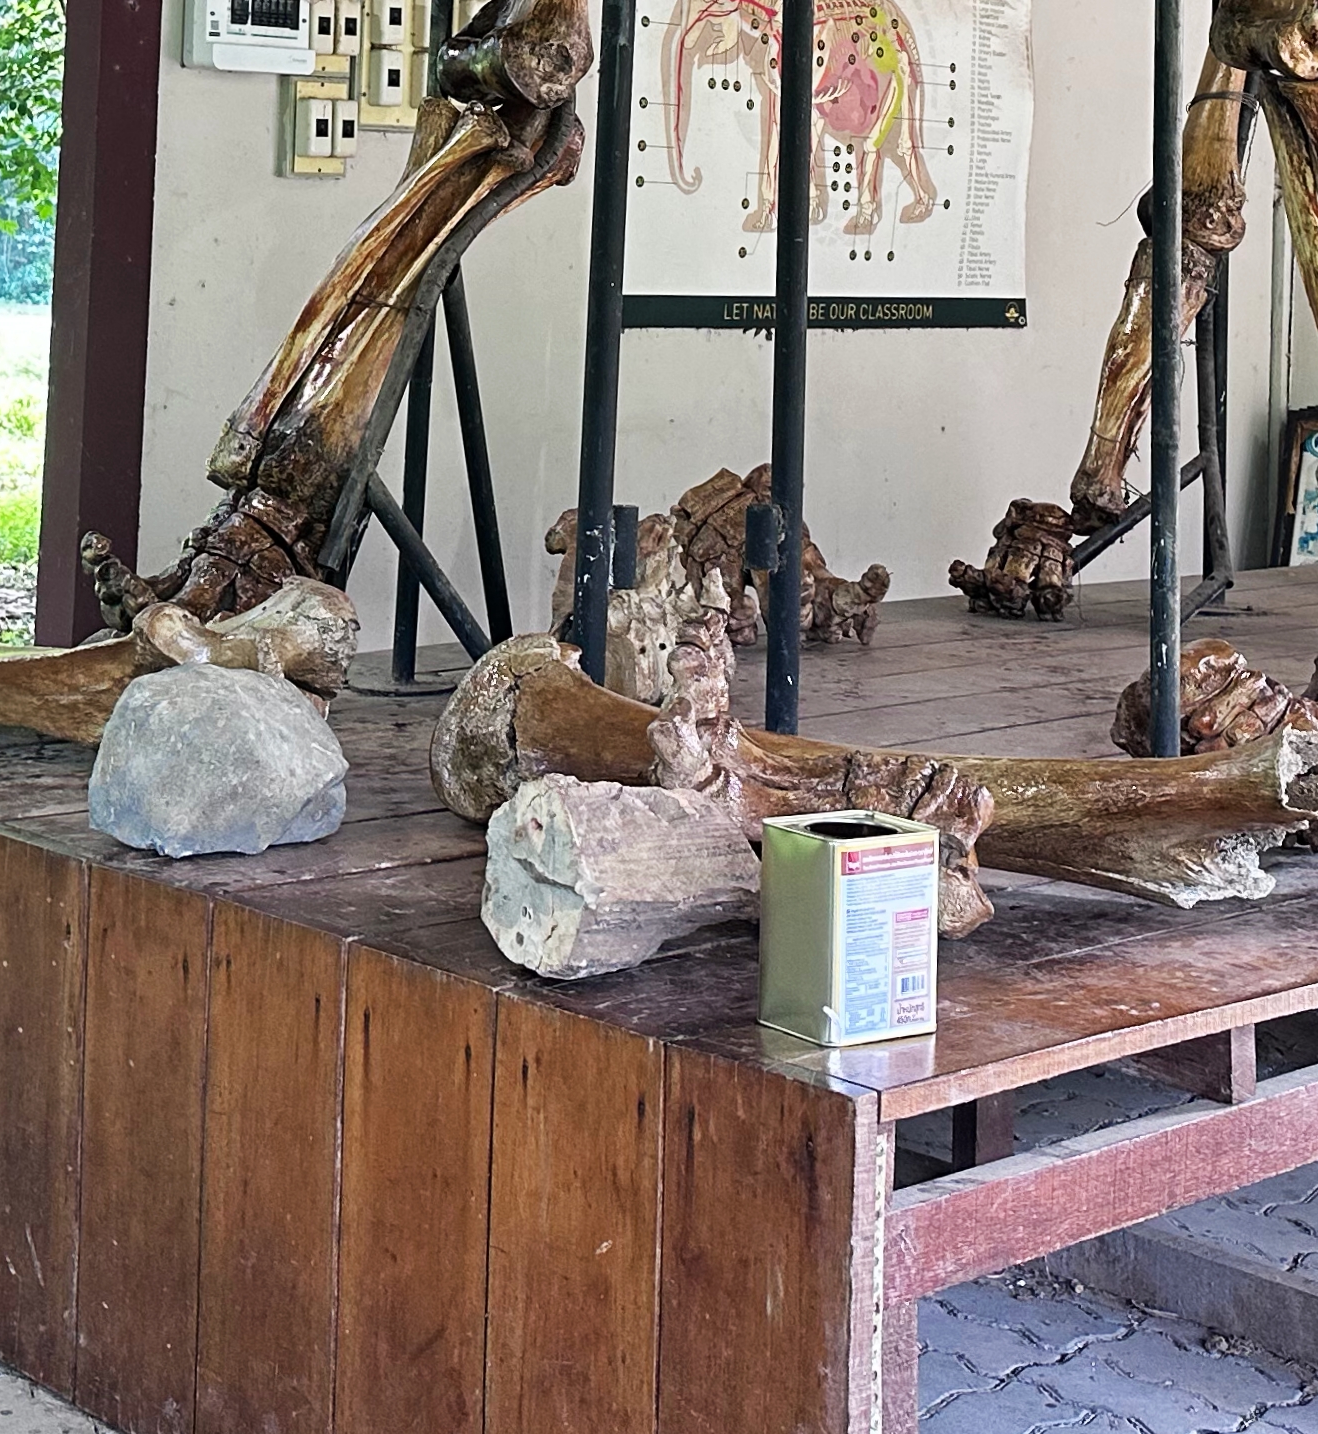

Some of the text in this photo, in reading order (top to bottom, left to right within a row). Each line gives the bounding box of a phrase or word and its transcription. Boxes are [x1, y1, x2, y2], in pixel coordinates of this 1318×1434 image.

[724, 304, 933, 319] LET NAT BE OUR CLASSROOM
